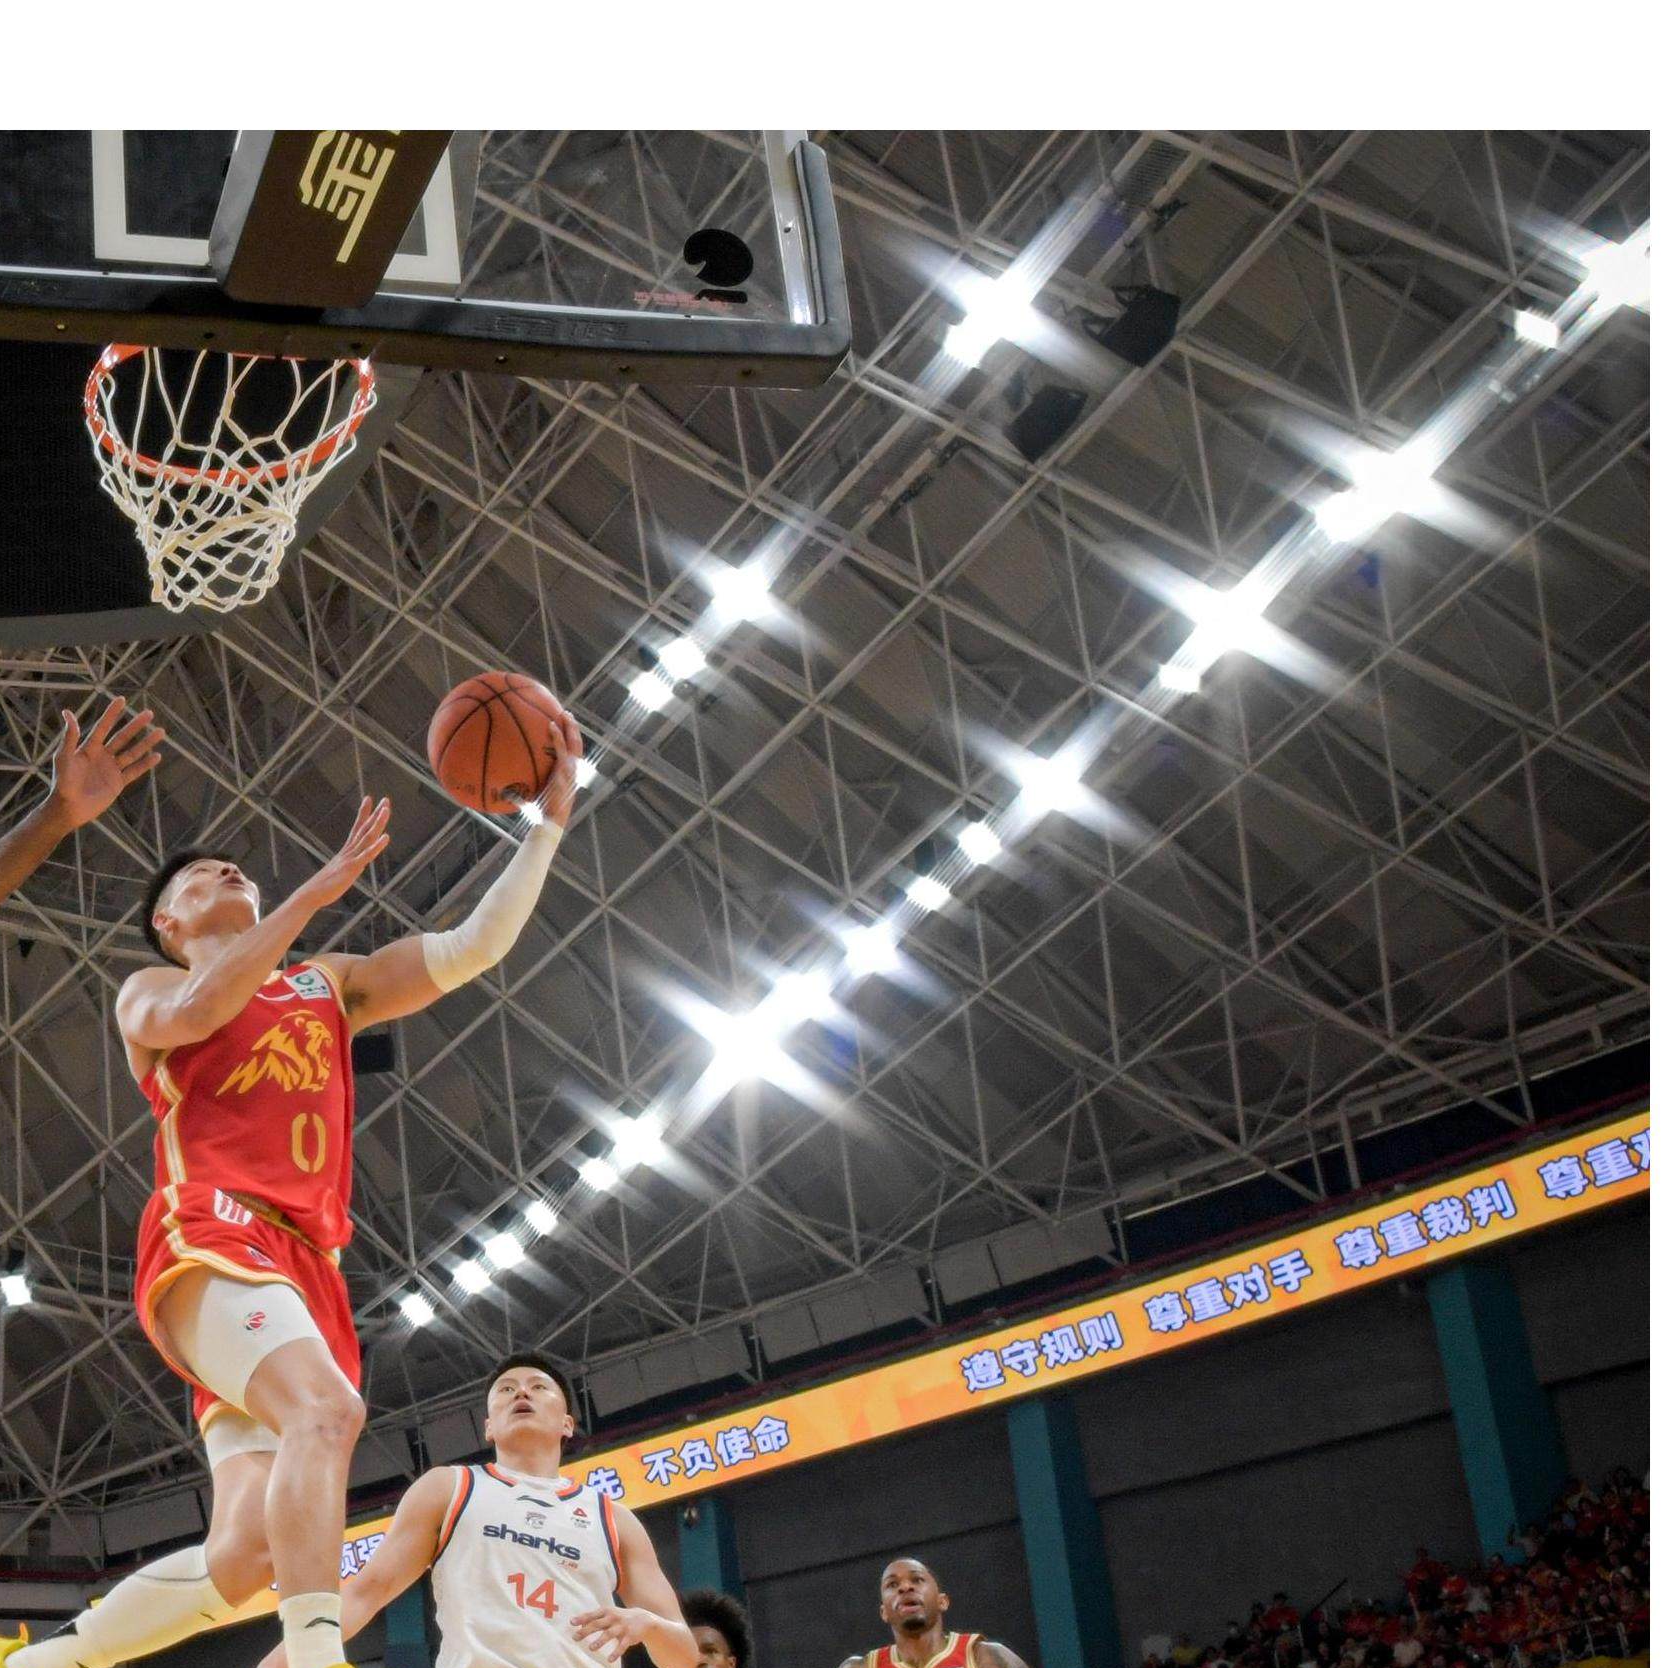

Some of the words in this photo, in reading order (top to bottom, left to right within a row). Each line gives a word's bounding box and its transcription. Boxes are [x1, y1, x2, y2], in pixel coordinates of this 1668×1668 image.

[291, 1112, 326, 1174] 0
[959, 1311, 1124, 1394] 遵守规则
[1143, 1249, 1313, 1334] 尊重对手
[1334, 1179, 1518, 1270] 尊重裁判
[642, 1415, 791, 1487] 不负使命
[483, 1523, 581, 1561] sharks
[507, 1572, 559, 1619] 14
